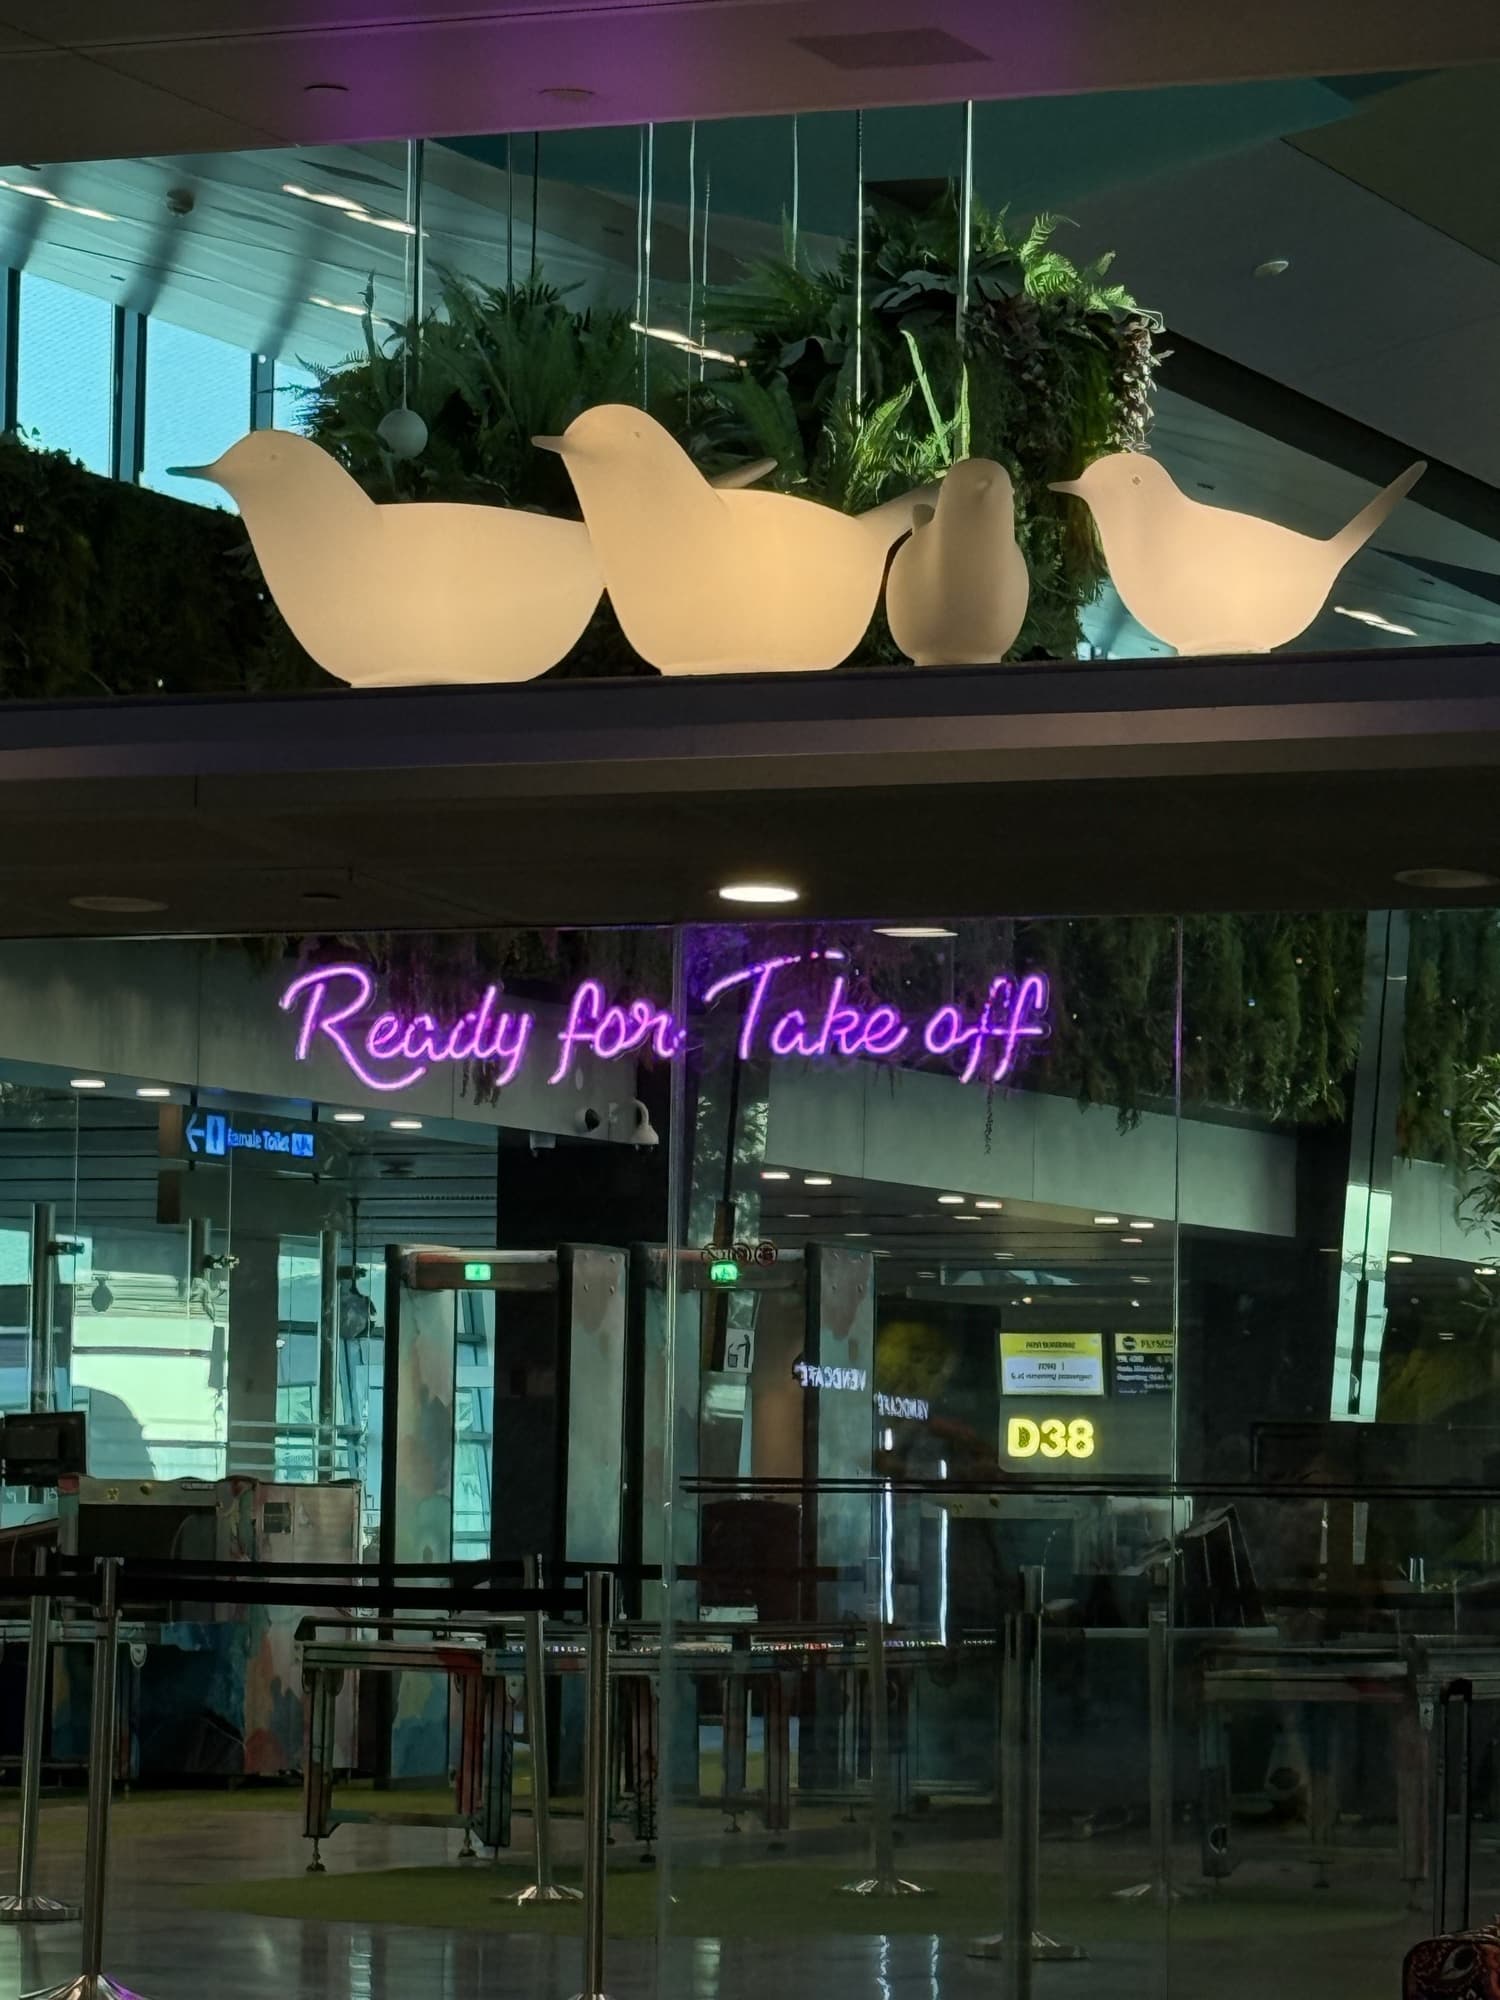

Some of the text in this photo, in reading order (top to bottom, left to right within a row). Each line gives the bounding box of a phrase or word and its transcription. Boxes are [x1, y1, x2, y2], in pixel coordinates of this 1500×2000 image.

[278, 949, 1045, 1091] Ready for Take off
[1007, 1417, 1095, 1459] D38
